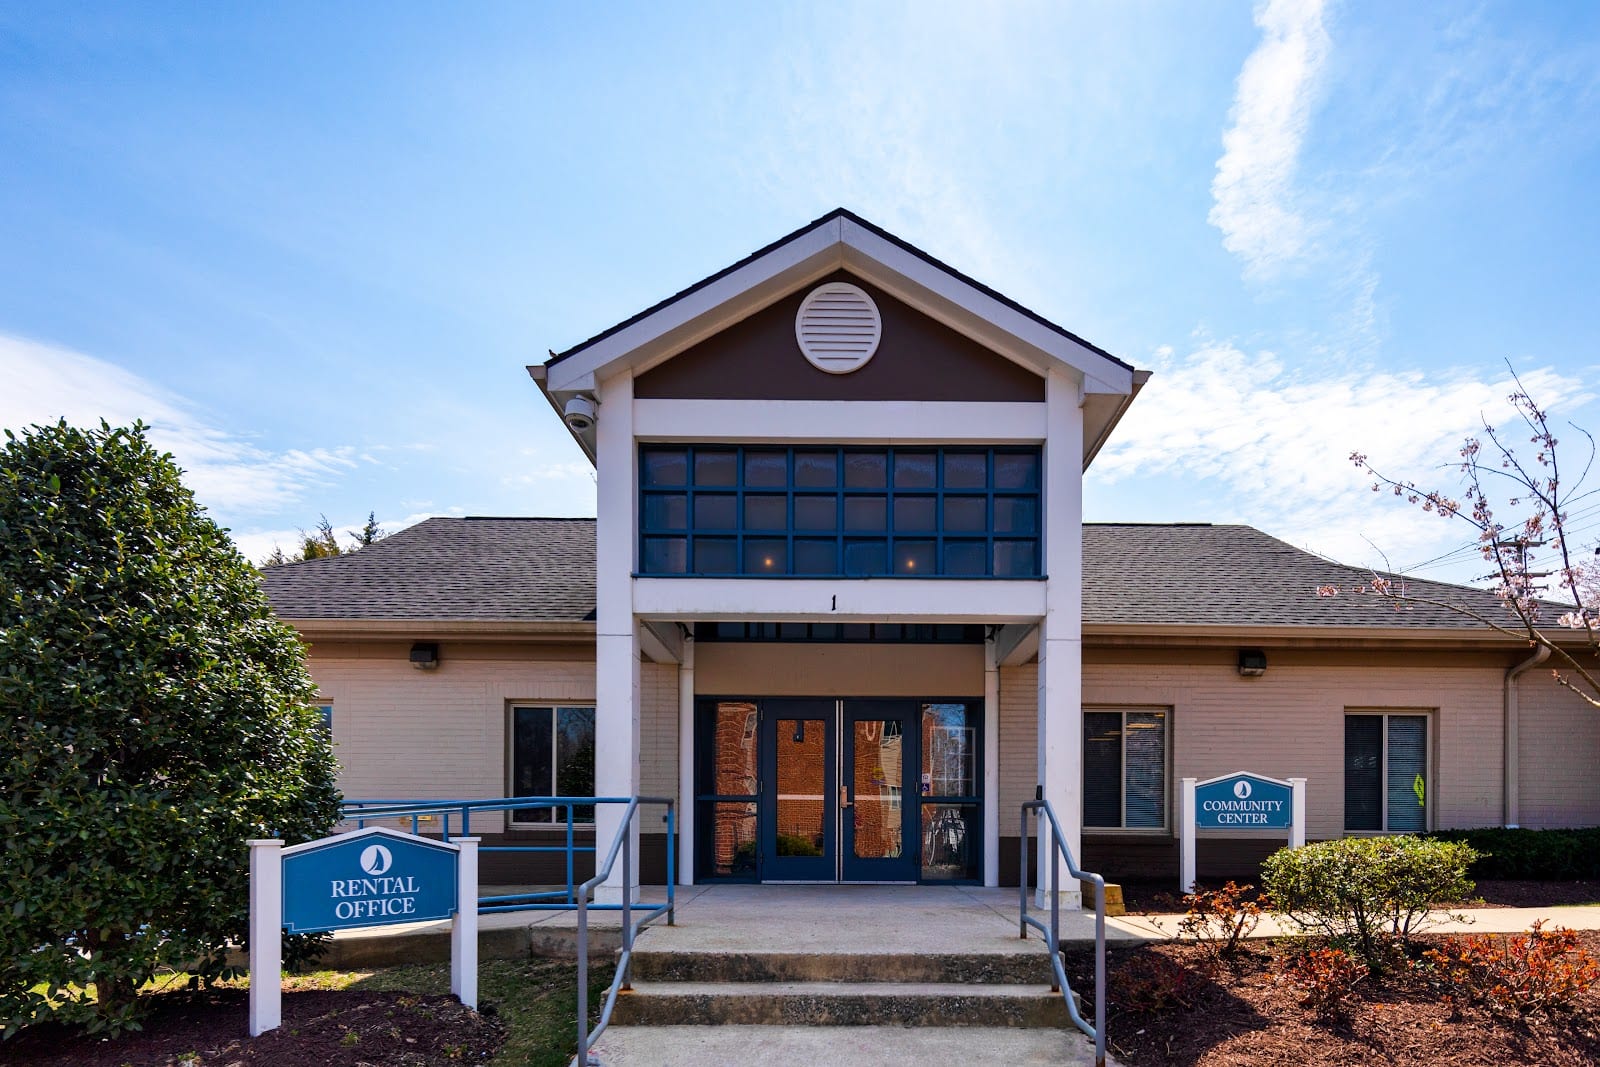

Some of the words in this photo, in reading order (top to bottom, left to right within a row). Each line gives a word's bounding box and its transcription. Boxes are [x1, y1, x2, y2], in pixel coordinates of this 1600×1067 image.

[831, 594, 837, 611] 1
[1203, 800, 1283, 811] COMMUNITY
[1217, 813, 1268, 824] CENTER
[330, 876, 420, 898] RENTAL
[335, 897, 416, 919] OFFICE
